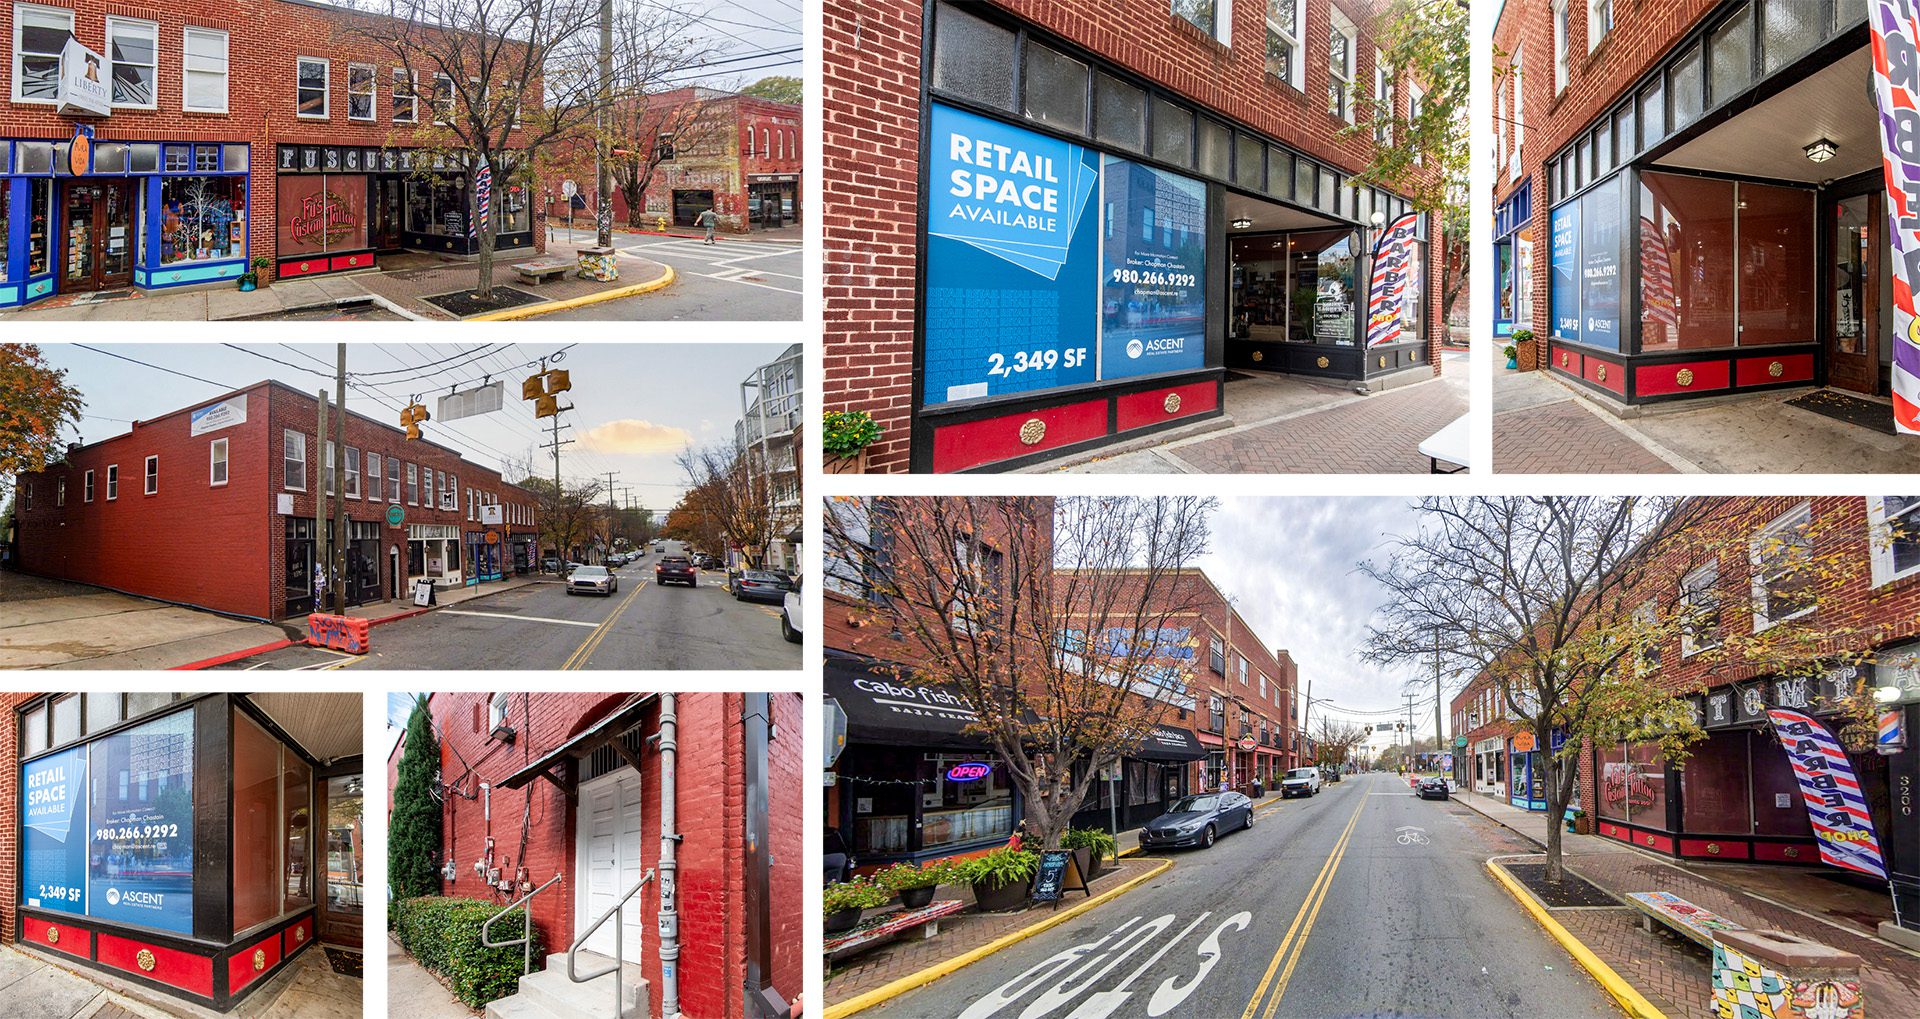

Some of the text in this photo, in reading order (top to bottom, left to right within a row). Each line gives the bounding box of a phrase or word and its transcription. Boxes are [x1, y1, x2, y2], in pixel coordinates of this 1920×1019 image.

[74, 76, 107, 97] LIBERTY
[950, 132, 1058, 184] RETAIL
[949, 169, 1058, 213] SPACE
[301, 197, 323, 220] Fu's
[948, 203, 1057, 232] AVAILABLE
[1554, 215, 1572, 232] RETAIL
[1554, 230, 1572, 248] SPACE
[1126, 257, 1144, 265] Broker:
[1144, 259, 1167, 268] Chapman
[1379, 227, 1407, 312] BARBER
[1113, 268, 1195, 287] 980.266.9292
[1595, 319, 1611, 330] ASCENT
[1145, 338, 1185, 352] ASCENT
[987, 347, 1087, 378] 2,349 SF
[853, 678, 961, 706] cabo fish
[889, 706, 934, 717] BAJA
[28, 766, 66, 789] RETAIL
[951, 766, 985, 779] OPEN
[28, 785, 66, 806] SPACE
[1900, 775, 1911, 816] 3200
[28, 803, 65, 817] AVAILABLE
[96, 823, 178, 840] 980.266.9292
[39, 884, 81, 902] 2,349 SF
[122, 891, 164, 905] ASCENT
